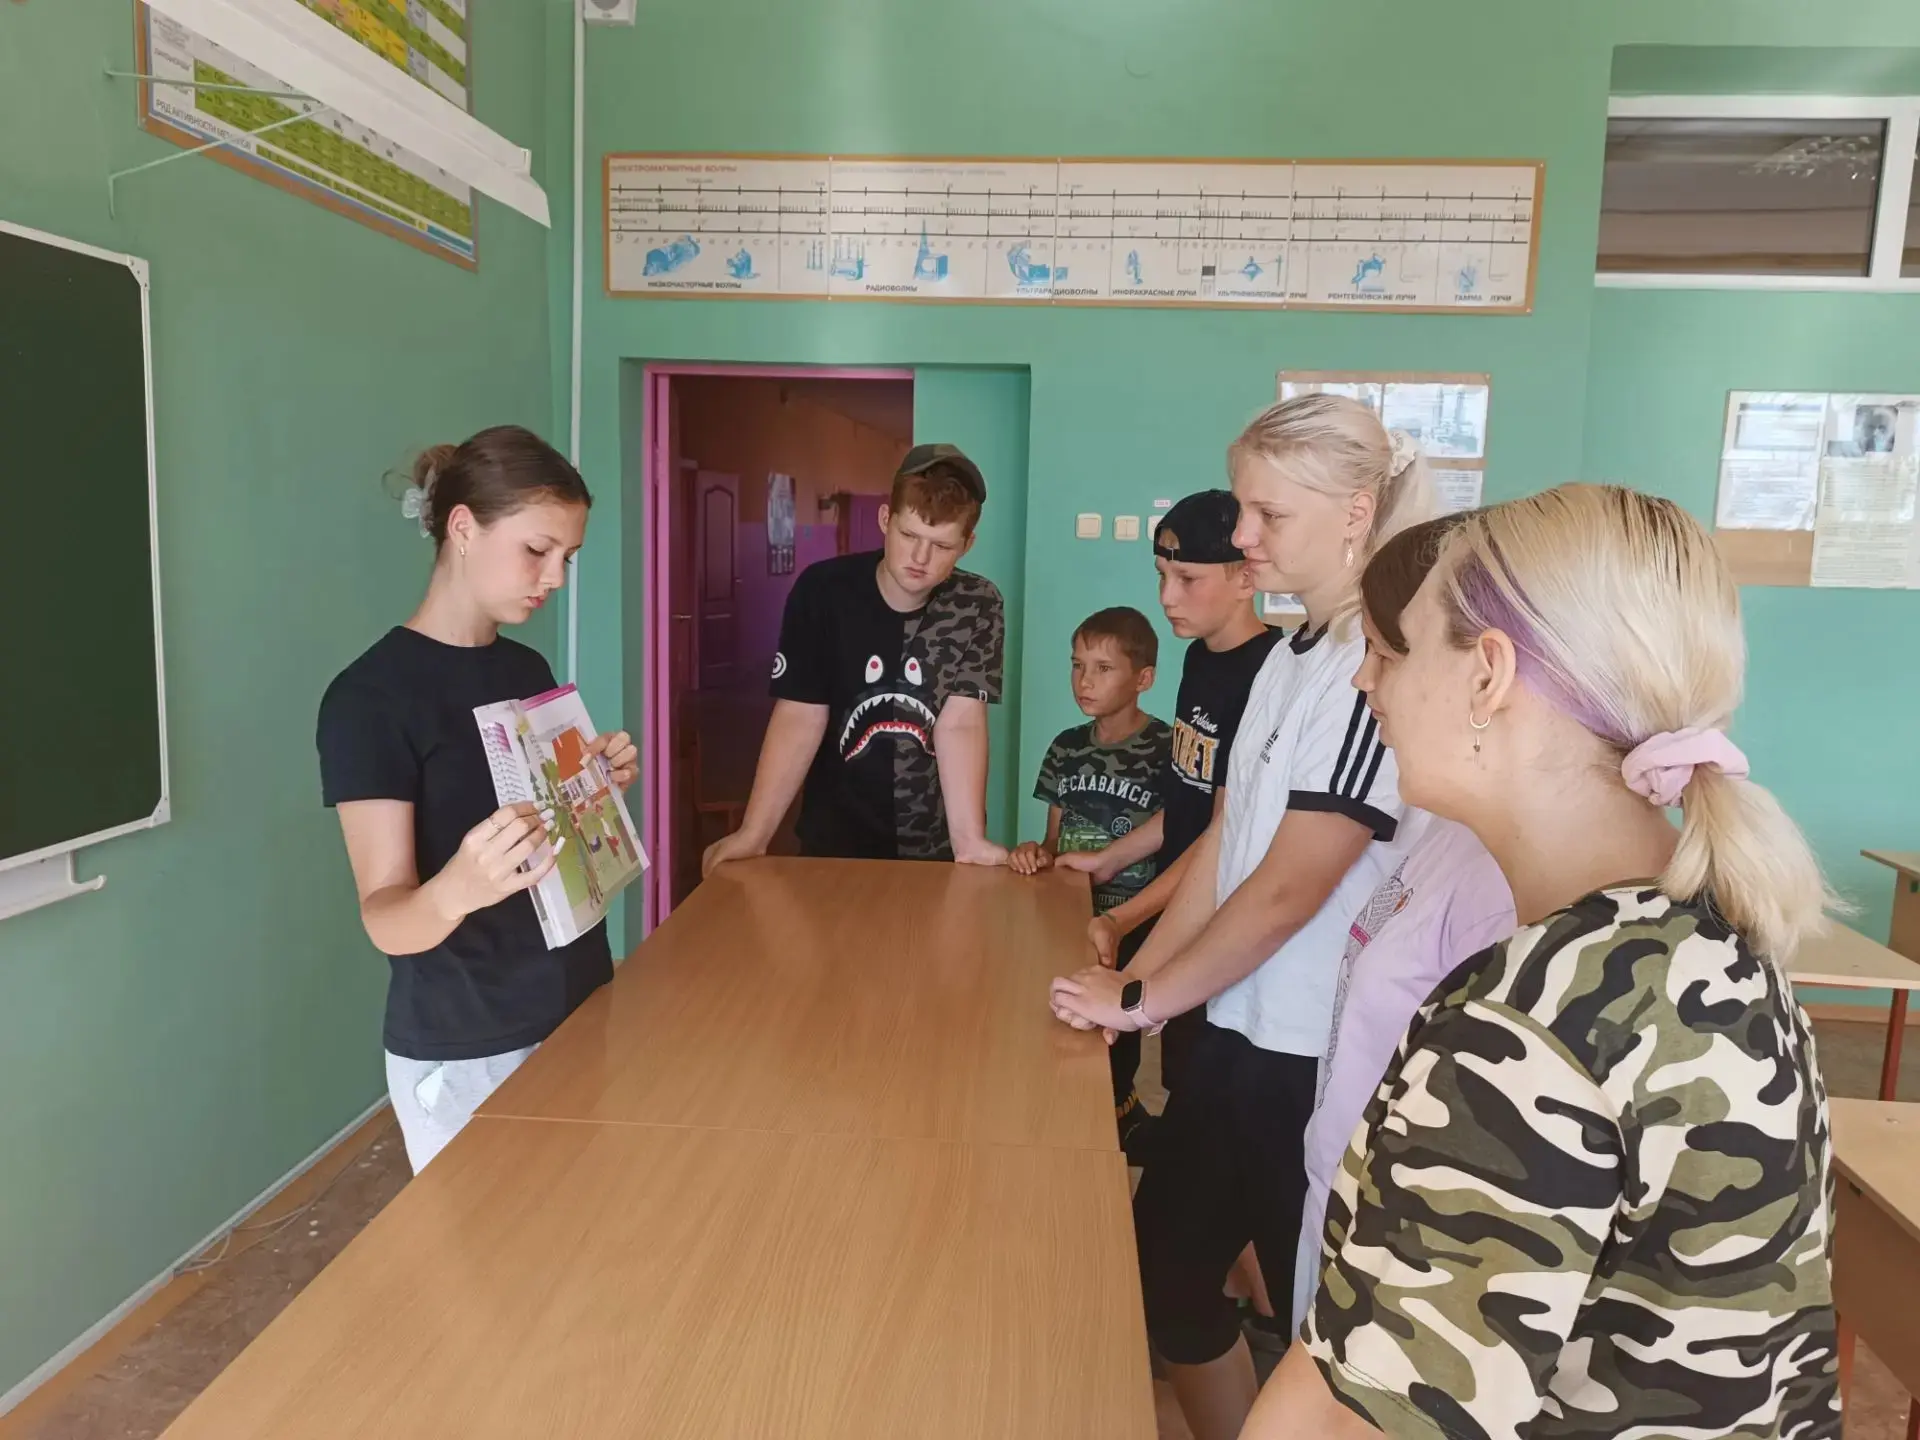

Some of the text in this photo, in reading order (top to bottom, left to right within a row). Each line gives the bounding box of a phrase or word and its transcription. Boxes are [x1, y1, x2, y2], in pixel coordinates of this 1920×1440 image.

[217, 128, 251, 151] МЕТЛОВ
[865, 284, 918, 292] РАДИОВОЛНЫ
[1069, 774, 1152, 808] СДАВАЙСЯ
